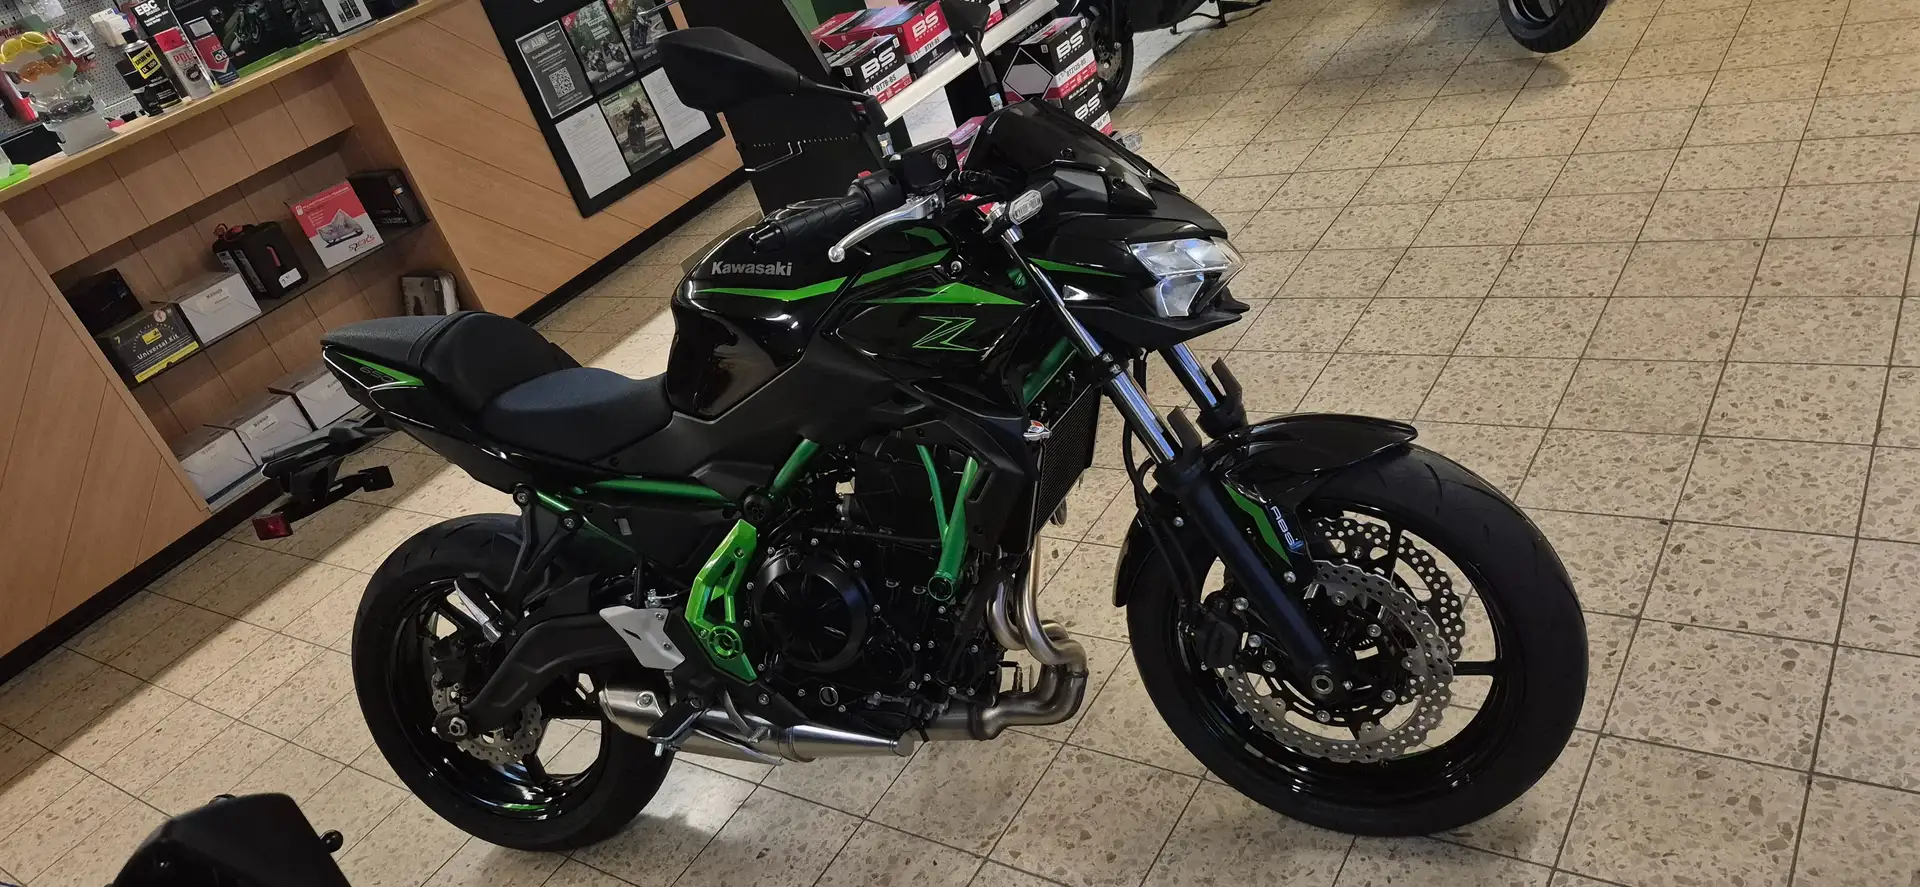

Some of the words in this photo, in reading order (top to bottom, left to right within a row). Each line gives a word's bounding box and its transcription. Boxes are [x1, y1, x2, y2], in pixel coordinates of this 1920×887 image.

[134, 0, 158, 16] EBC
[911, 10, 940, 39] BS
[915, 23, 941, 42] BATTERY
[531, 34, 547, 49] AUK
[1056, 30, 1084, 59] BS
[860, 46, 896, 80] BS
[865, 60, 898, 83] BATTERY
[1074, 93, 1100, 120] BS
[711, 260, 792, 277] Kawasaki
[136, 339, 168, 361] Universal
[167, 332, 179, 343] Kit
[359, 366, 394, 383] 650
[1270, 506, 1295, 546] ABS
